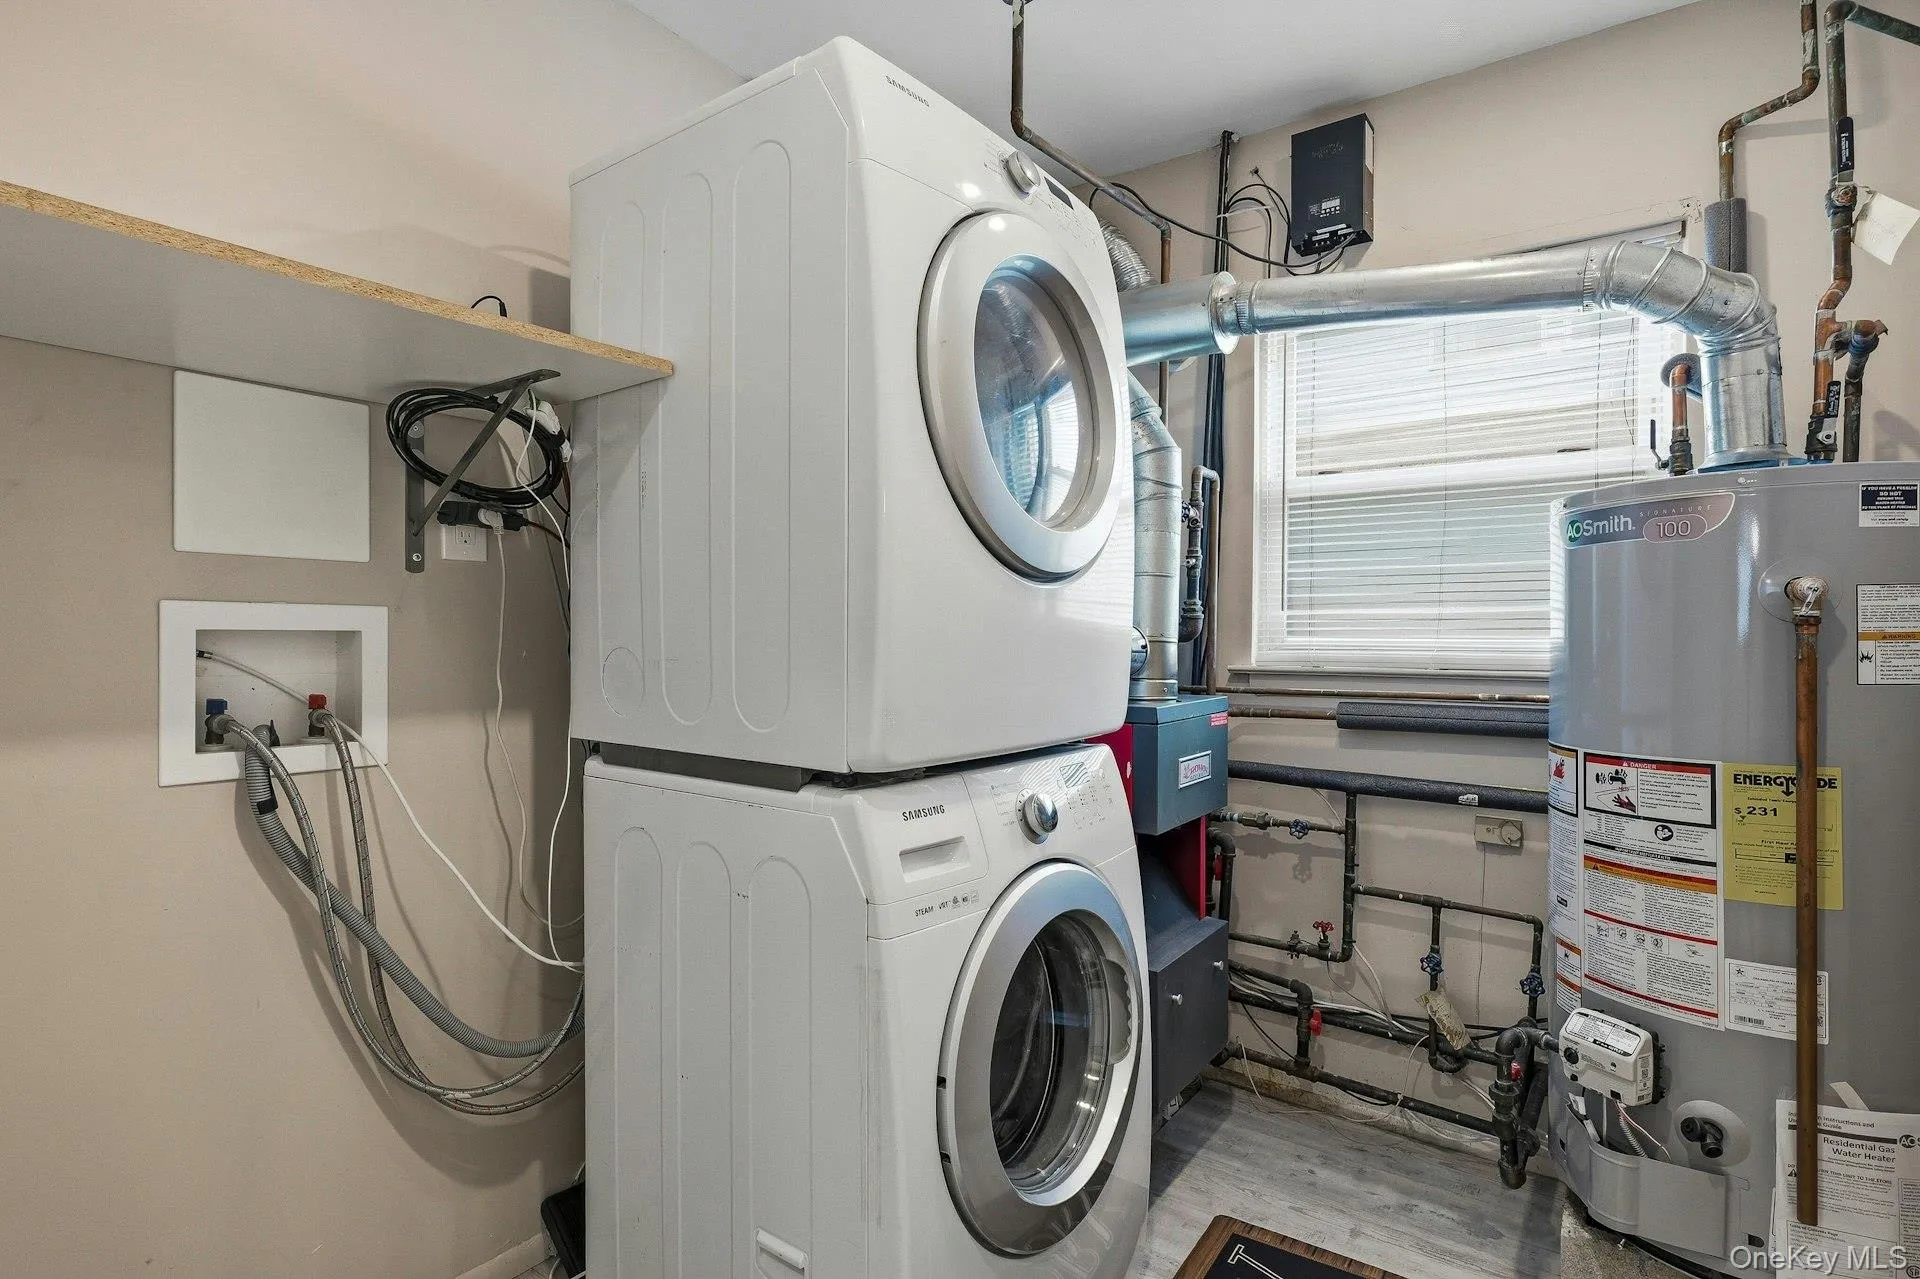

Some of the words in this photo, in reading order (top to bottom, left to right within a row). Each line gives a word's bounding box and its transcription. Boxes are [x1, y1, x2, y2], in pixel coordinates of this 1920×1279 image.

[885, 75, 930, 107] SAMSUNG
[1658, 520, 1691, 538] 100
[1630, 761, 1657, 770] DANGER
[901, 804, 945, 821] SAMSUNG
[1747, 806, 1778, 817] 231
[914, 905, 934, 917] STEAM
[1823, 1136, 1876, 1152] Residential
[1878, 1145, 1896, 1154] Gas
[1832, 1147, 1862, 1159] Water
[1864, 1152, 1897, 1164] Heater
